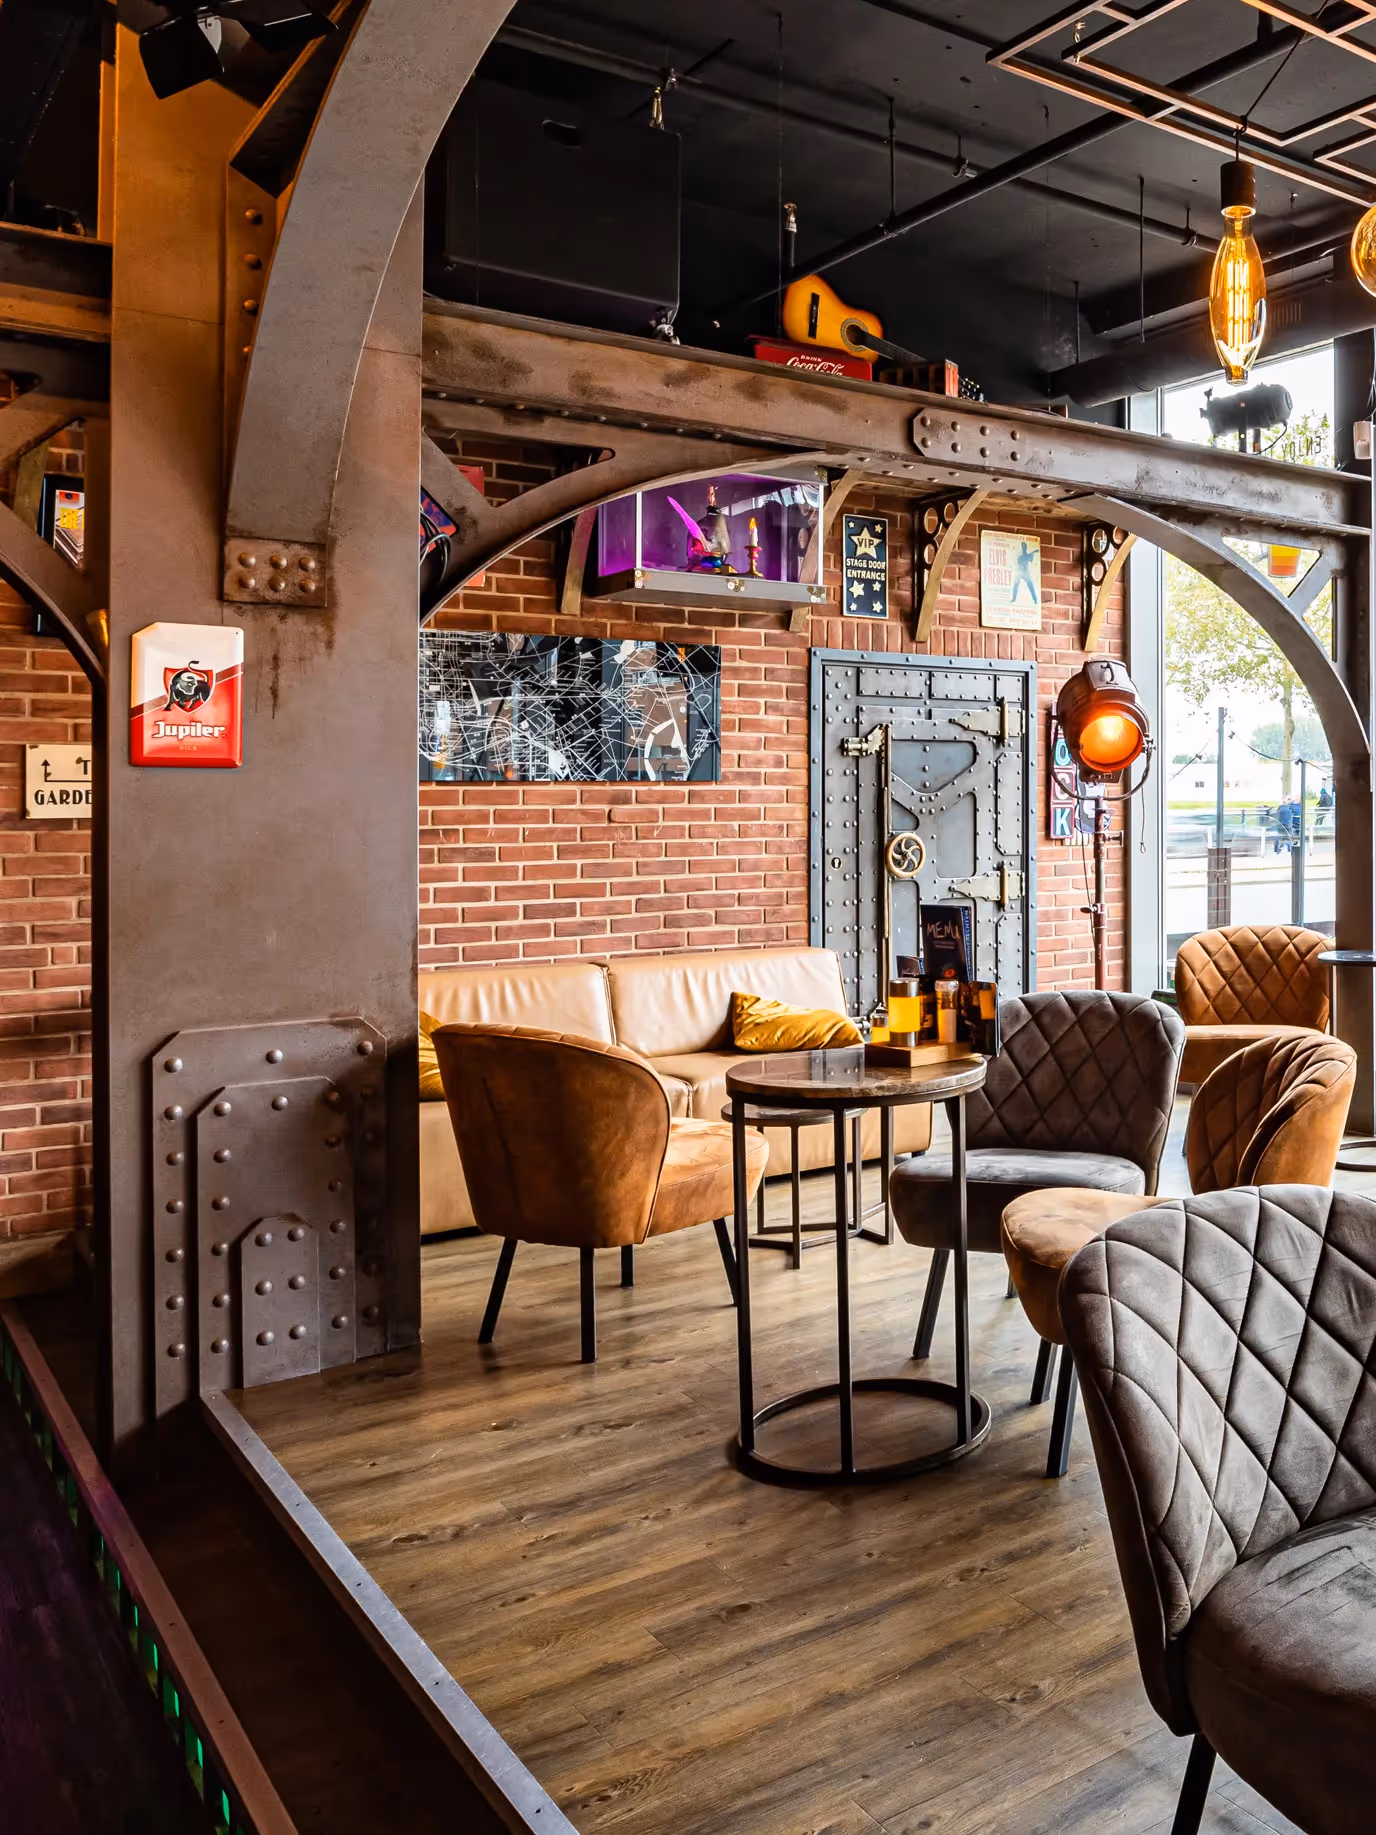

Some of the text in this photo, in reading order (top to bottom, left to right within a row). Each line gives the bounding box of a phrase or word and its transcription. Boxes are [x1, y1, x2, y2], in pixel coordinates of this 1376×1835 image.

[787, 356, 845, 376] Coca-Cla
[800, 354, 822, 362] DRINK
[857, 537, 875, 549] VIP
[846, 558, 886, 570] STAGE DOOR
[988, 548, 1007, 567] ELVIS
[846, 569, 886, 580] ENTRANCE
[151, 721, 226, 740] Jupiler
[34, 789, 92, 806] GARDE
[926, 920, 961, 939] MENU
